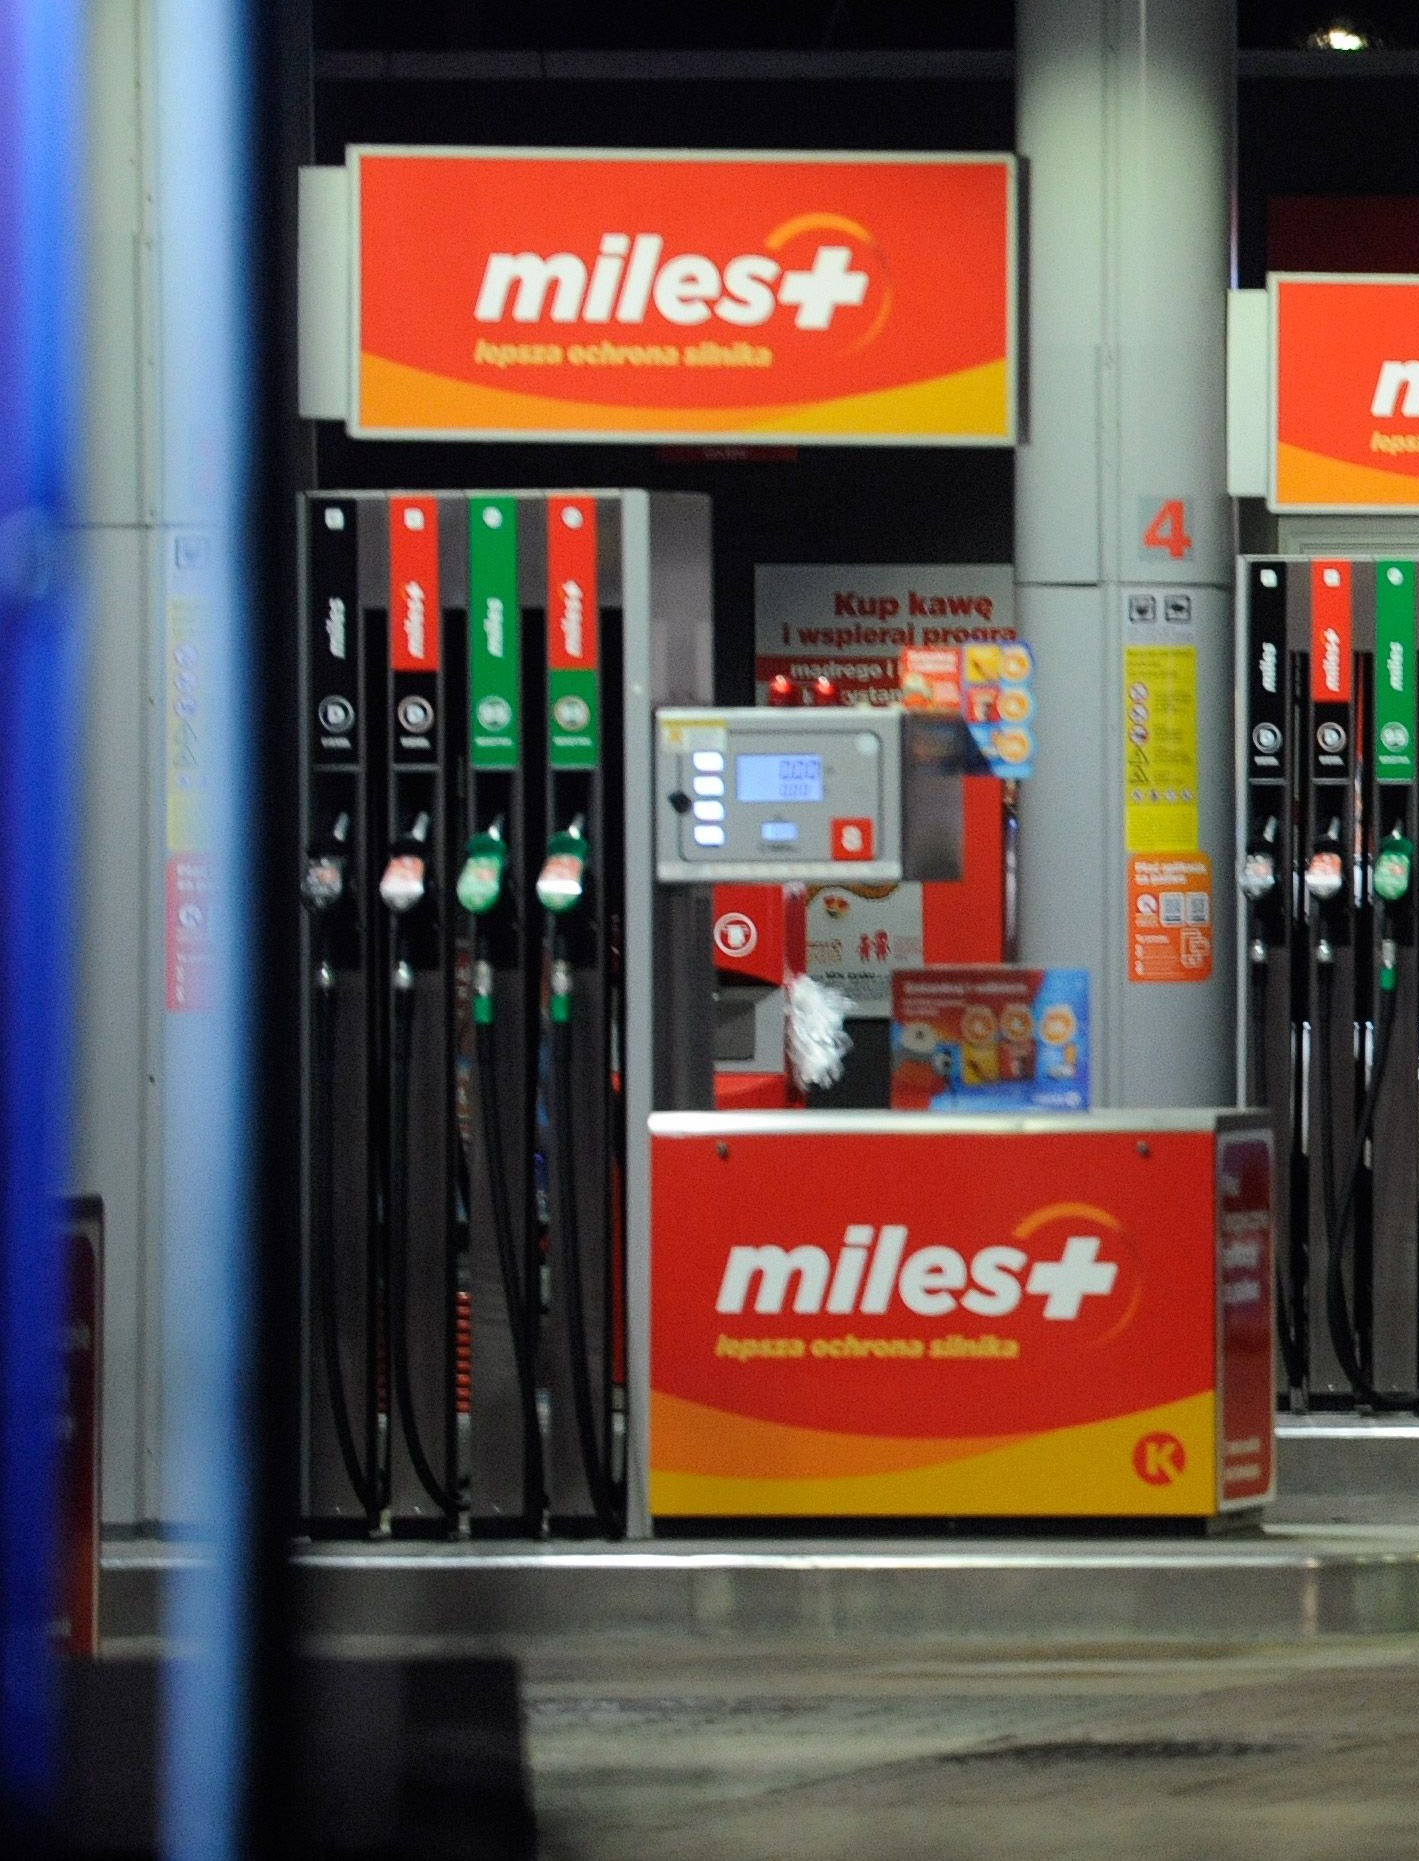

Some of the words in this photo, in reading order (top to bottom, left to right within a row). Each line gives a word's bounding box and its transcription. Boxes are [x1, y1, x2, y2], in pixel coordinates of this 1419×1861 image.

[475, 234, 868, 329] miles+
[474, 339, 562, 368] lepsza
[568, 340, 680, 366] ochrona
[683, 341, 772, 367] silnika
[1143, 499, 1192, 560] 4
[834, 591, 901, 620] Kup
[908, 590, 994, 621] kawę
[922, 626, 1017, 648] progra
[716, 1225, 1117, 1319] miles+
[716, 1335, 804, 1362] lepsza
[810, 1335, 924, 1358] ochrona
[930, 1335, 1019, 1359] silnika
